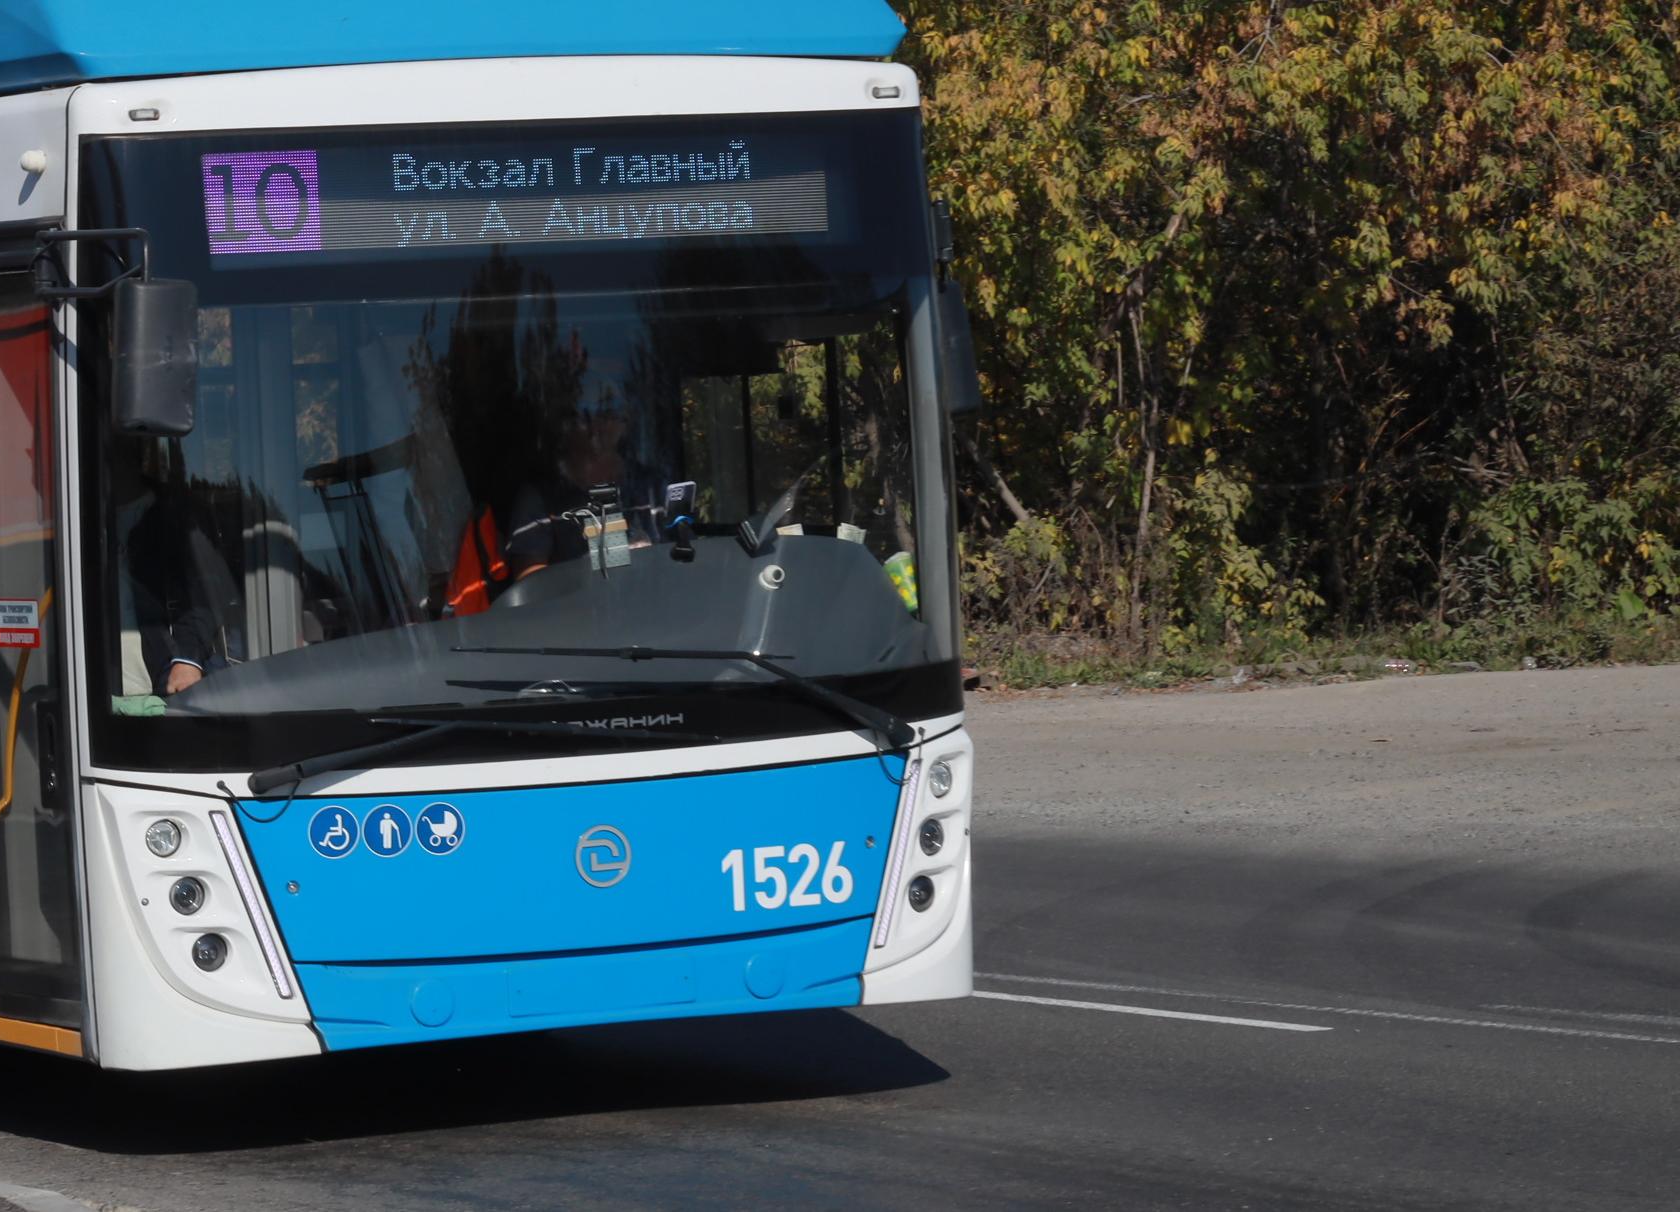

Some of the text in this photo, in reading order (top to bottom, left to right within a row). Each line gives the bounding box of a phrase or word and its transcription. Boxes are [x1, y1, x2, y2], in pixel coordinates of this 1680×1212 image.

[393, 139, 751, 191] Вокзал Главный
[210, 162, 309, 241] 10
[393, 198, 753, 248] ул. А. Анцупова
[721, 840, 854, 912] 1526
